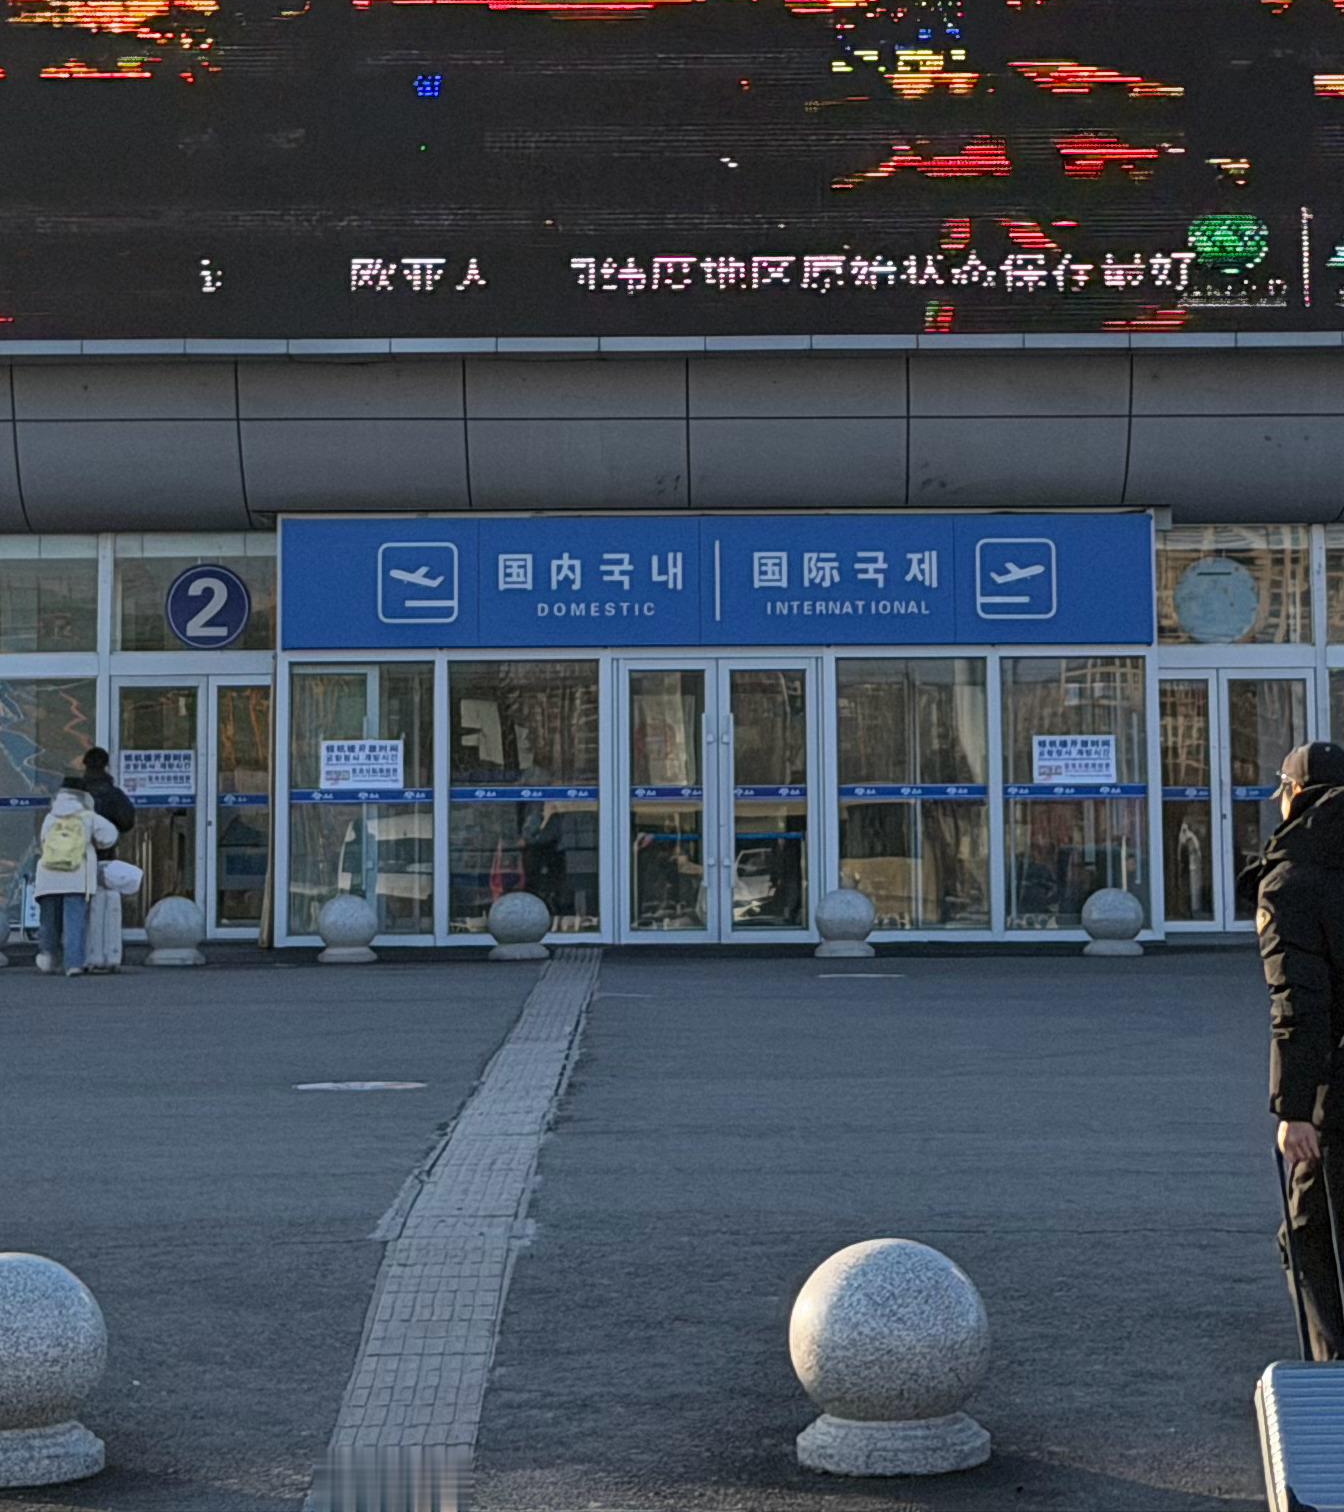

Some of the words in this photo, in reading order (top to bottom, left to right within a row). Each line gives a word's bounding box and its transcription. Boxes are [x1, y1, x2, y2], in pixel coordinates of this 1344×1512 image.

[186, 579, 228, 638] 2
[537, 601, 657, 617] DOMESTIC
[766, 600, 931, 616] INTERNATIONAL
